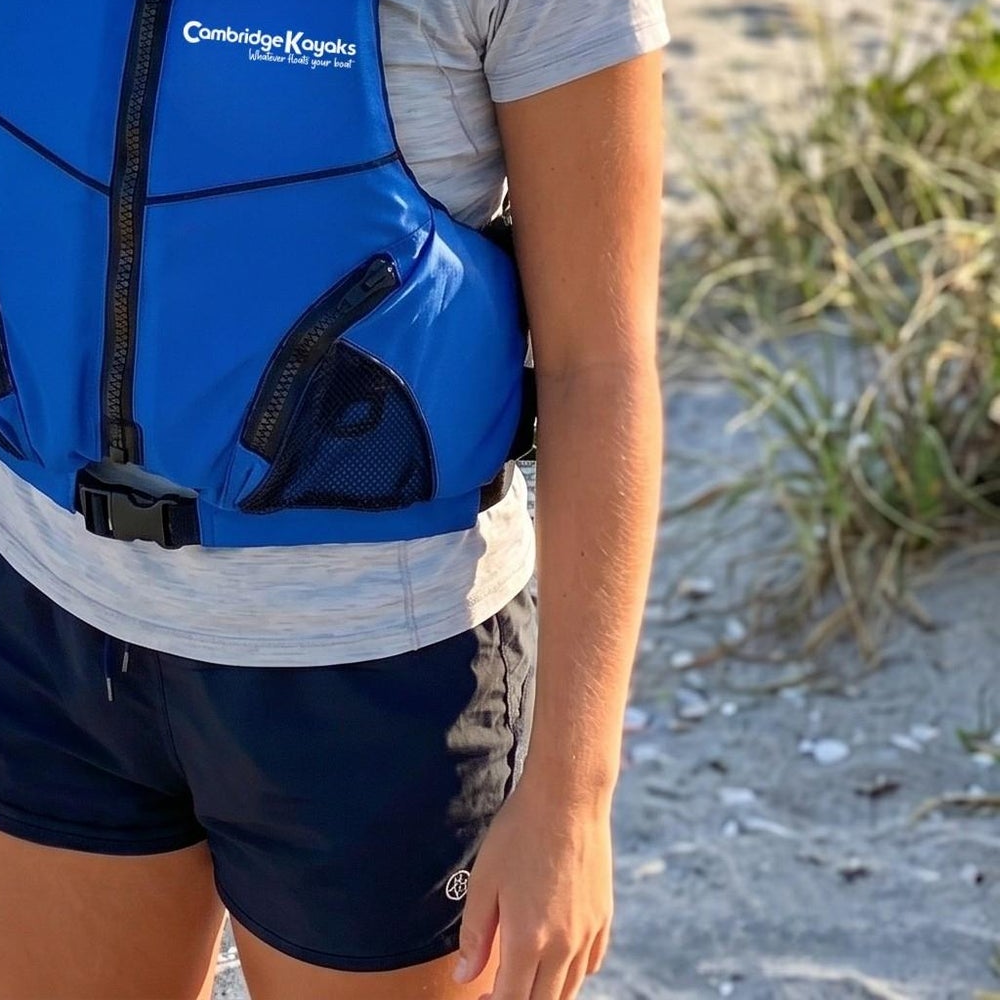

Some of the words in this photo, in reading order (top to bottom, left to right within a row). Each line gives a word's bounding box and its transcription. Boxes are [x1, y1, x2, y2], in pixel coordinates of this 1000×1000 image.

[248, 48, 286, 63] Whatever
[287, 53, 309, 66] floats
[311, 60, 332, 70] your
[333, 57, 355, 69] boat
